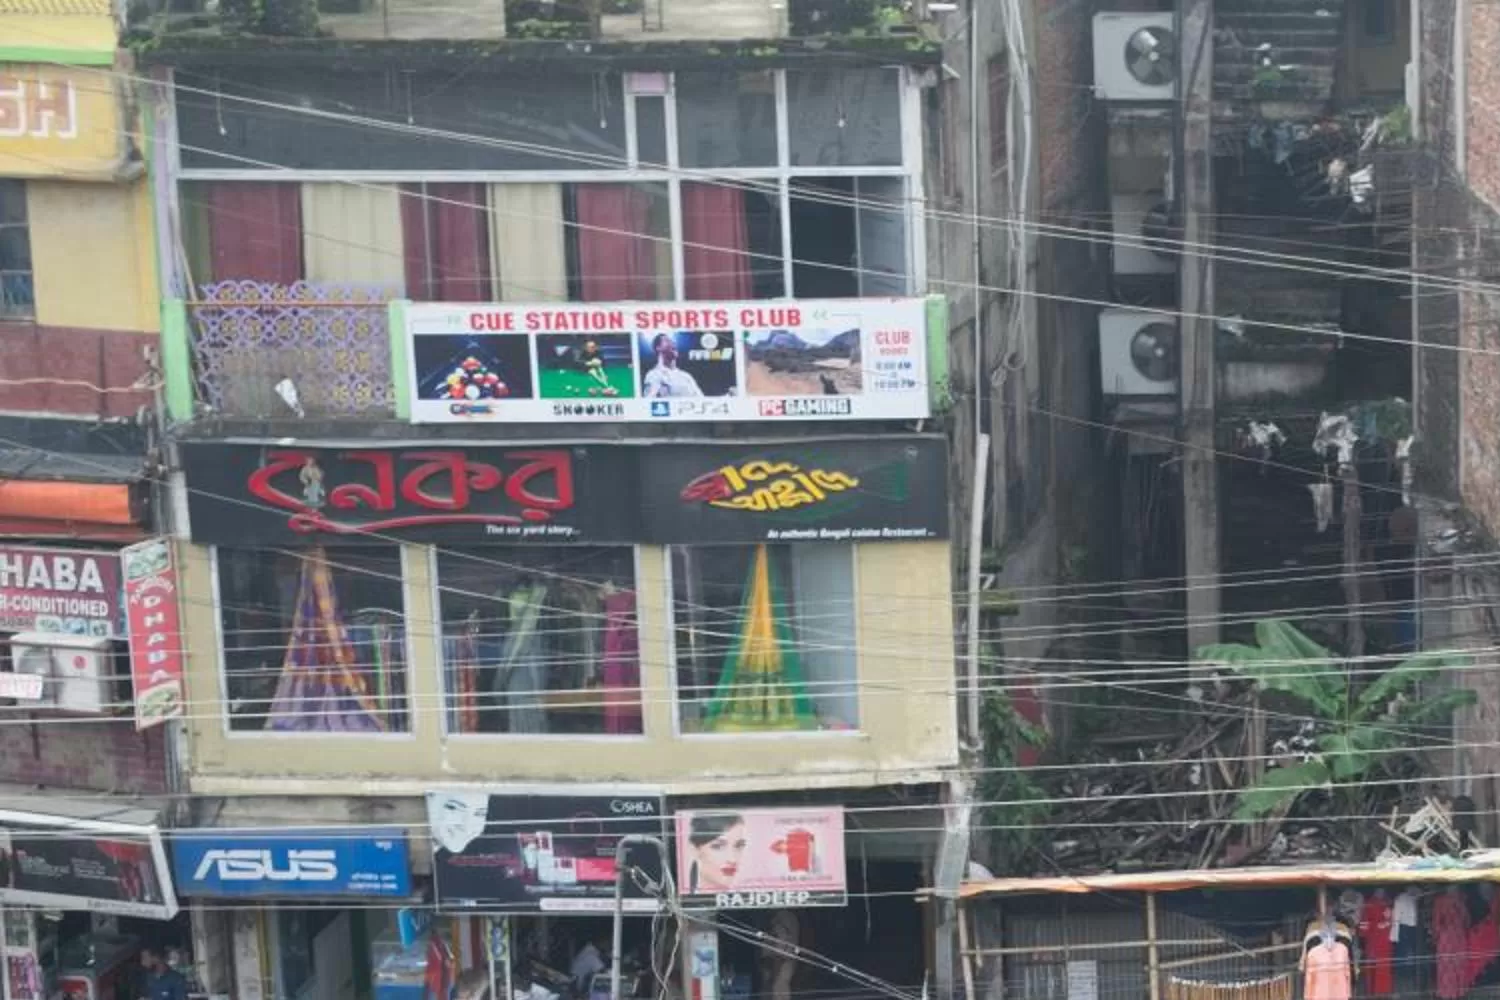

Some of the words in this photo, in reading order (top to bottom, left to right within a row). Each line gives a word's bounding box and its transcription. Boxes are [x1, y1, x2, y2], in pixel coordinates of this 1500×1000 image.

[470, 312, 514, 331] CUE
[525, 310, 624, 331] STATION
[635, 309, 729, 330] SPORTS
[740, 307, 801, 327] CLUB
[875, 331, 911, 345] CLUB
[0, 553, 105, 594] HABA
[193, 849, 339, 881] ASUS
